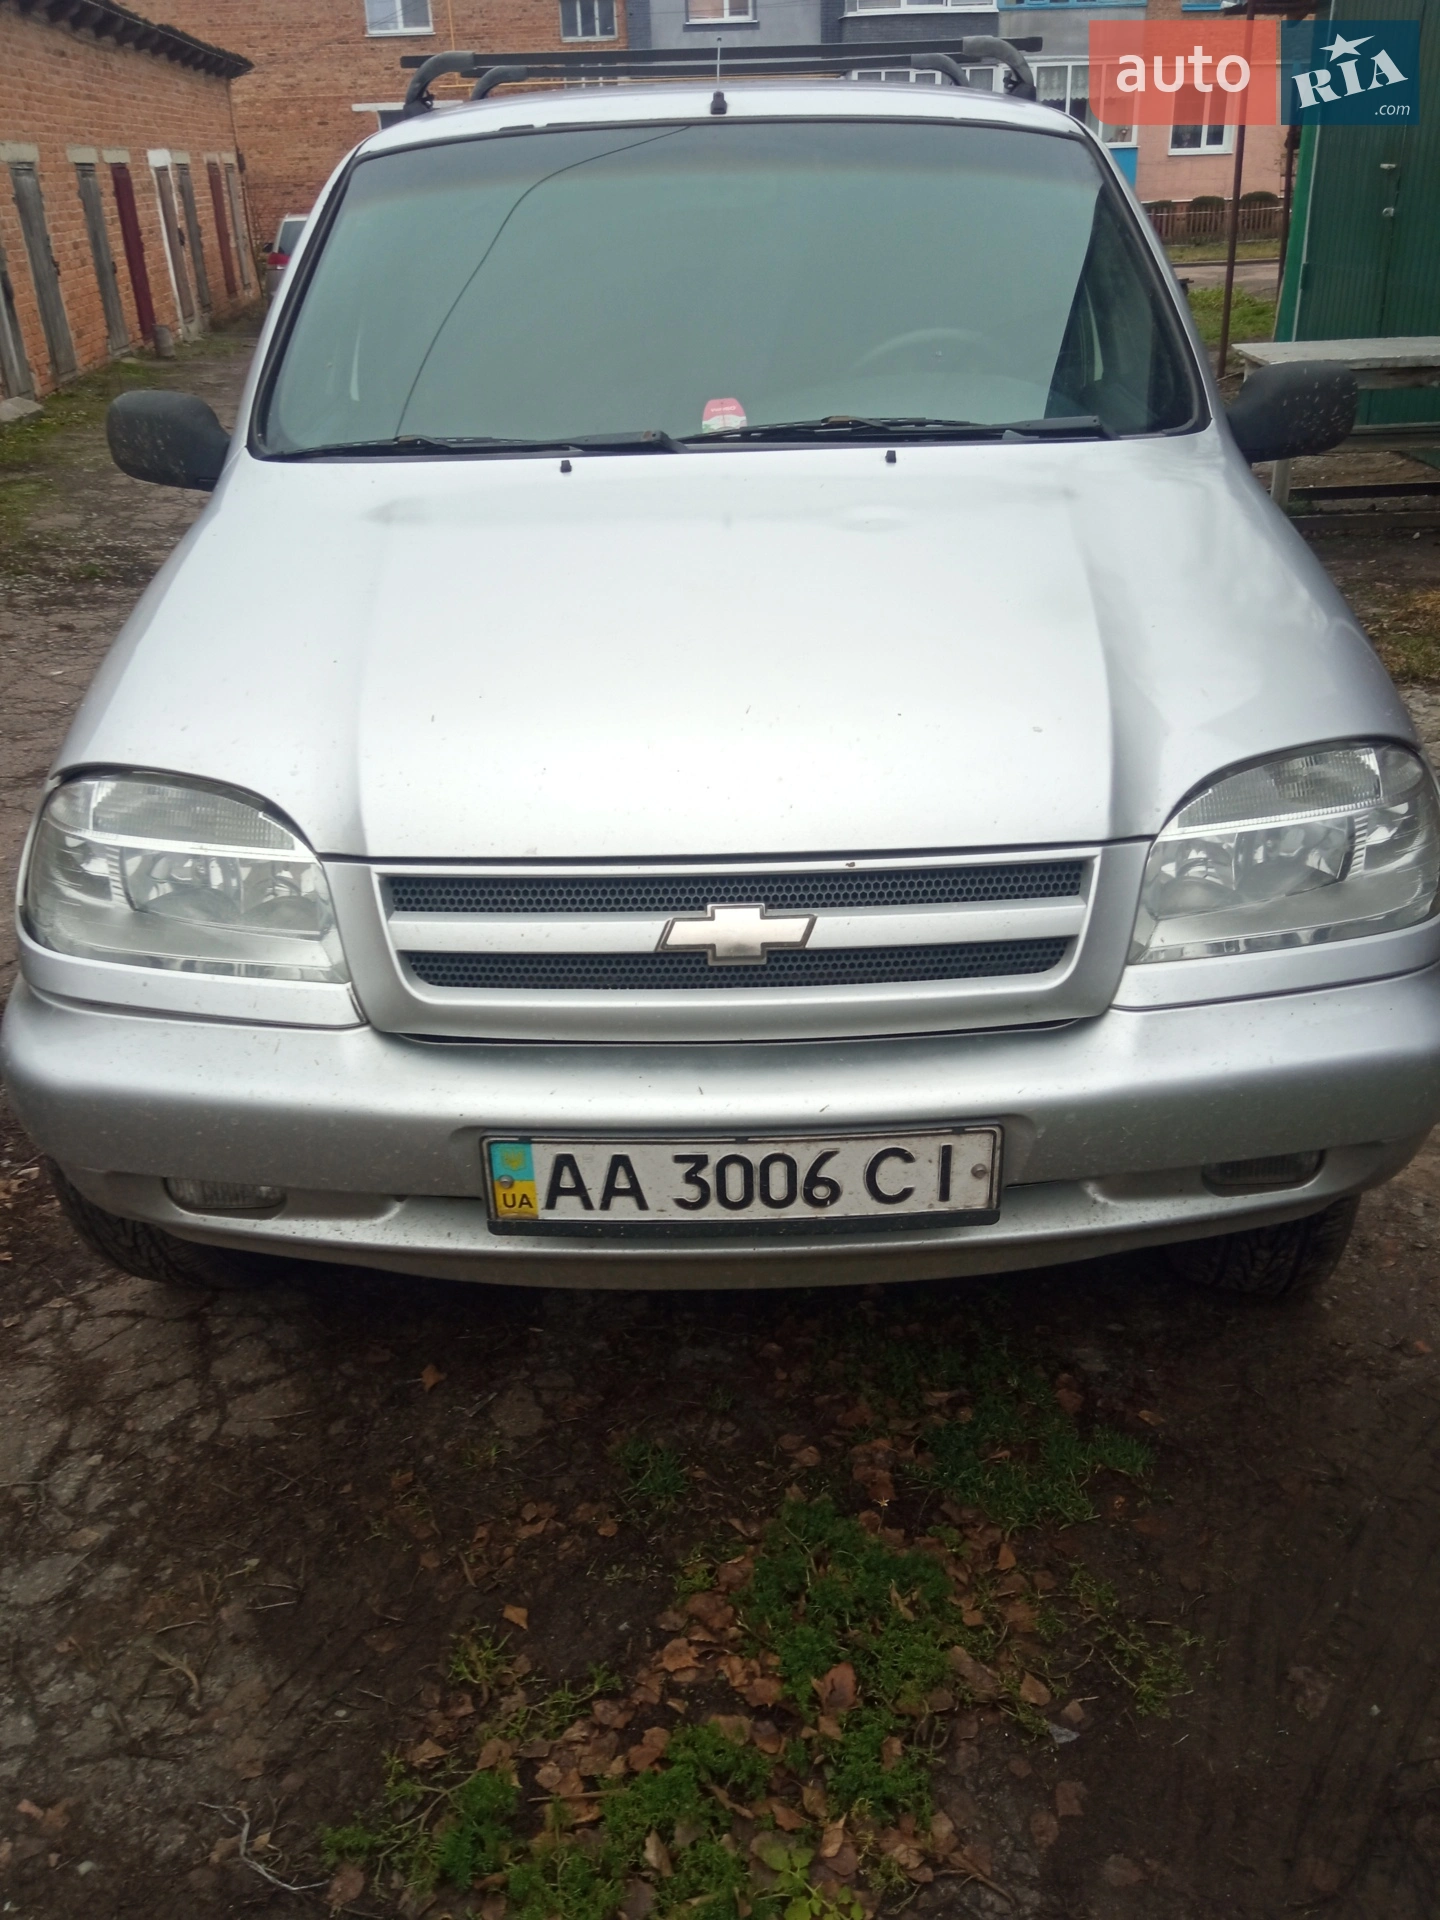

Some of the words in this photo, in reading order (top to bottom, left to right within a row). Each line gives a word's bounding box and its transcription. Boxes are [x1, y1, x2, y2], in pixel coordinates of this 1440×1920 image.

[544, 1152, 650, 1212] AA
[672, 1147, 844, 1211] 3006
[864, 1143, 954, 1206] CI
[502, 1191, 534, 1211] UA
